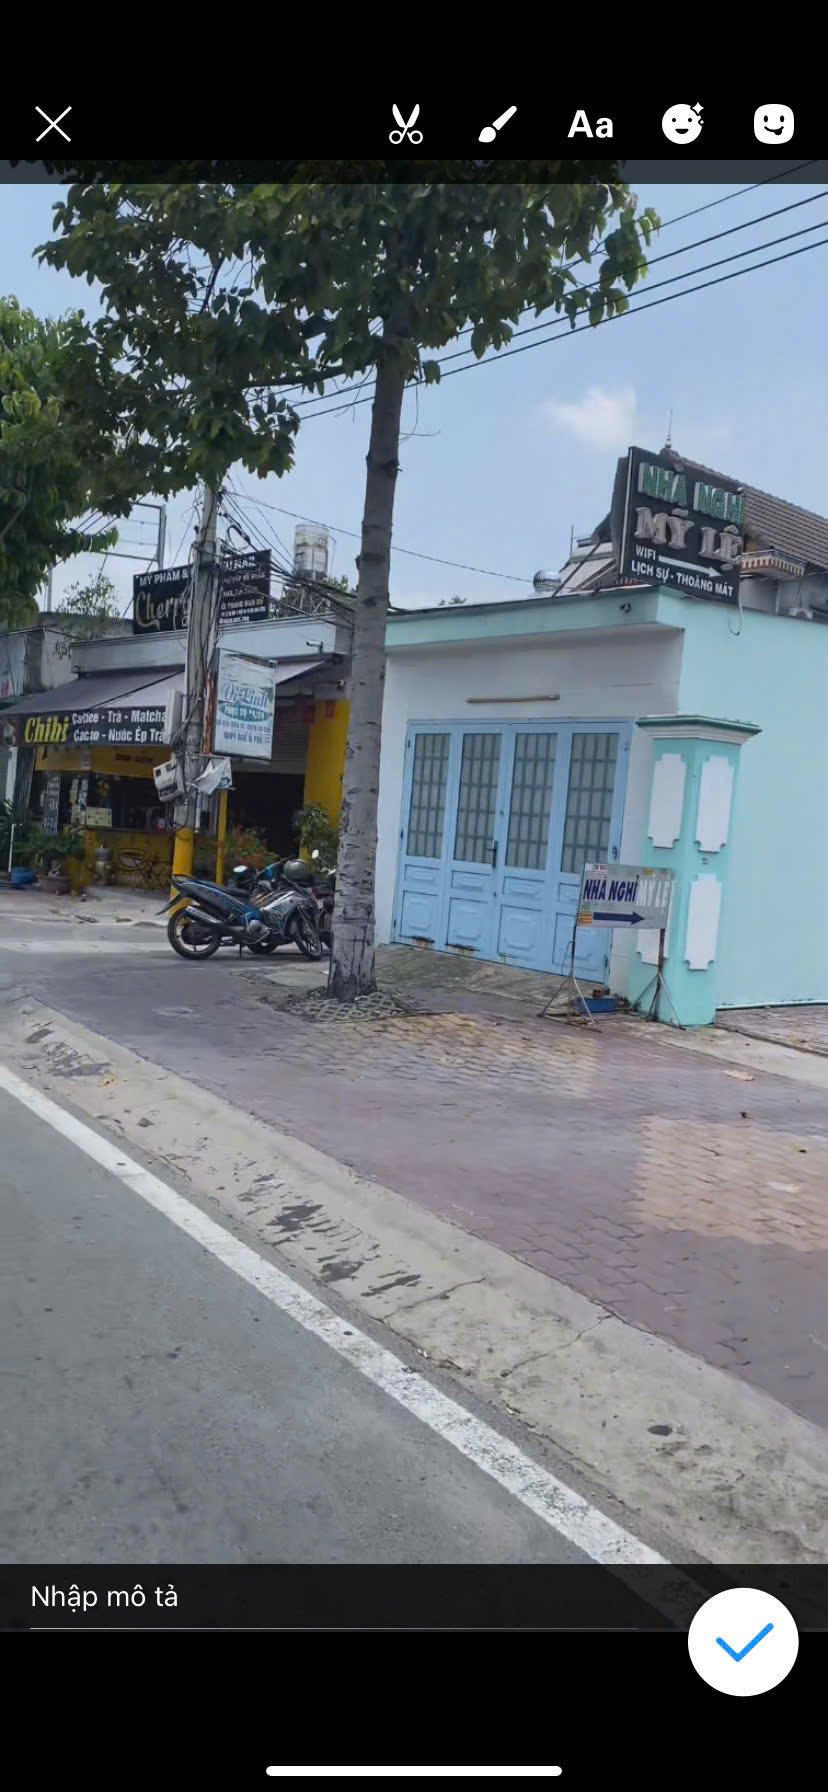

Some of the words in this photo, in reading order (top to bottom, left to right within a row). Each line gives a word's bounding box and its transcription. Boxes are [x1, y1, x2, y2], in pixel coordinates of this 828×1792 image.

[638, 462, 688, 507] NHÀ
[634, 506, 695, 550] MỸ
[698, 524, 743, 572] LỆ
[635, 544, 657, 561] WIFI
[631, 559, 654, 577] LỊCH
[655, 567, 670, 584] SỰ
[714, 581, 734, 597] MÁT
[24, 715, 71, 745] Chibi
[107, 710, 122, 723] Trà
[73, 728, 100, 742] Cacao
[135, 725, 147, 743] Ép
